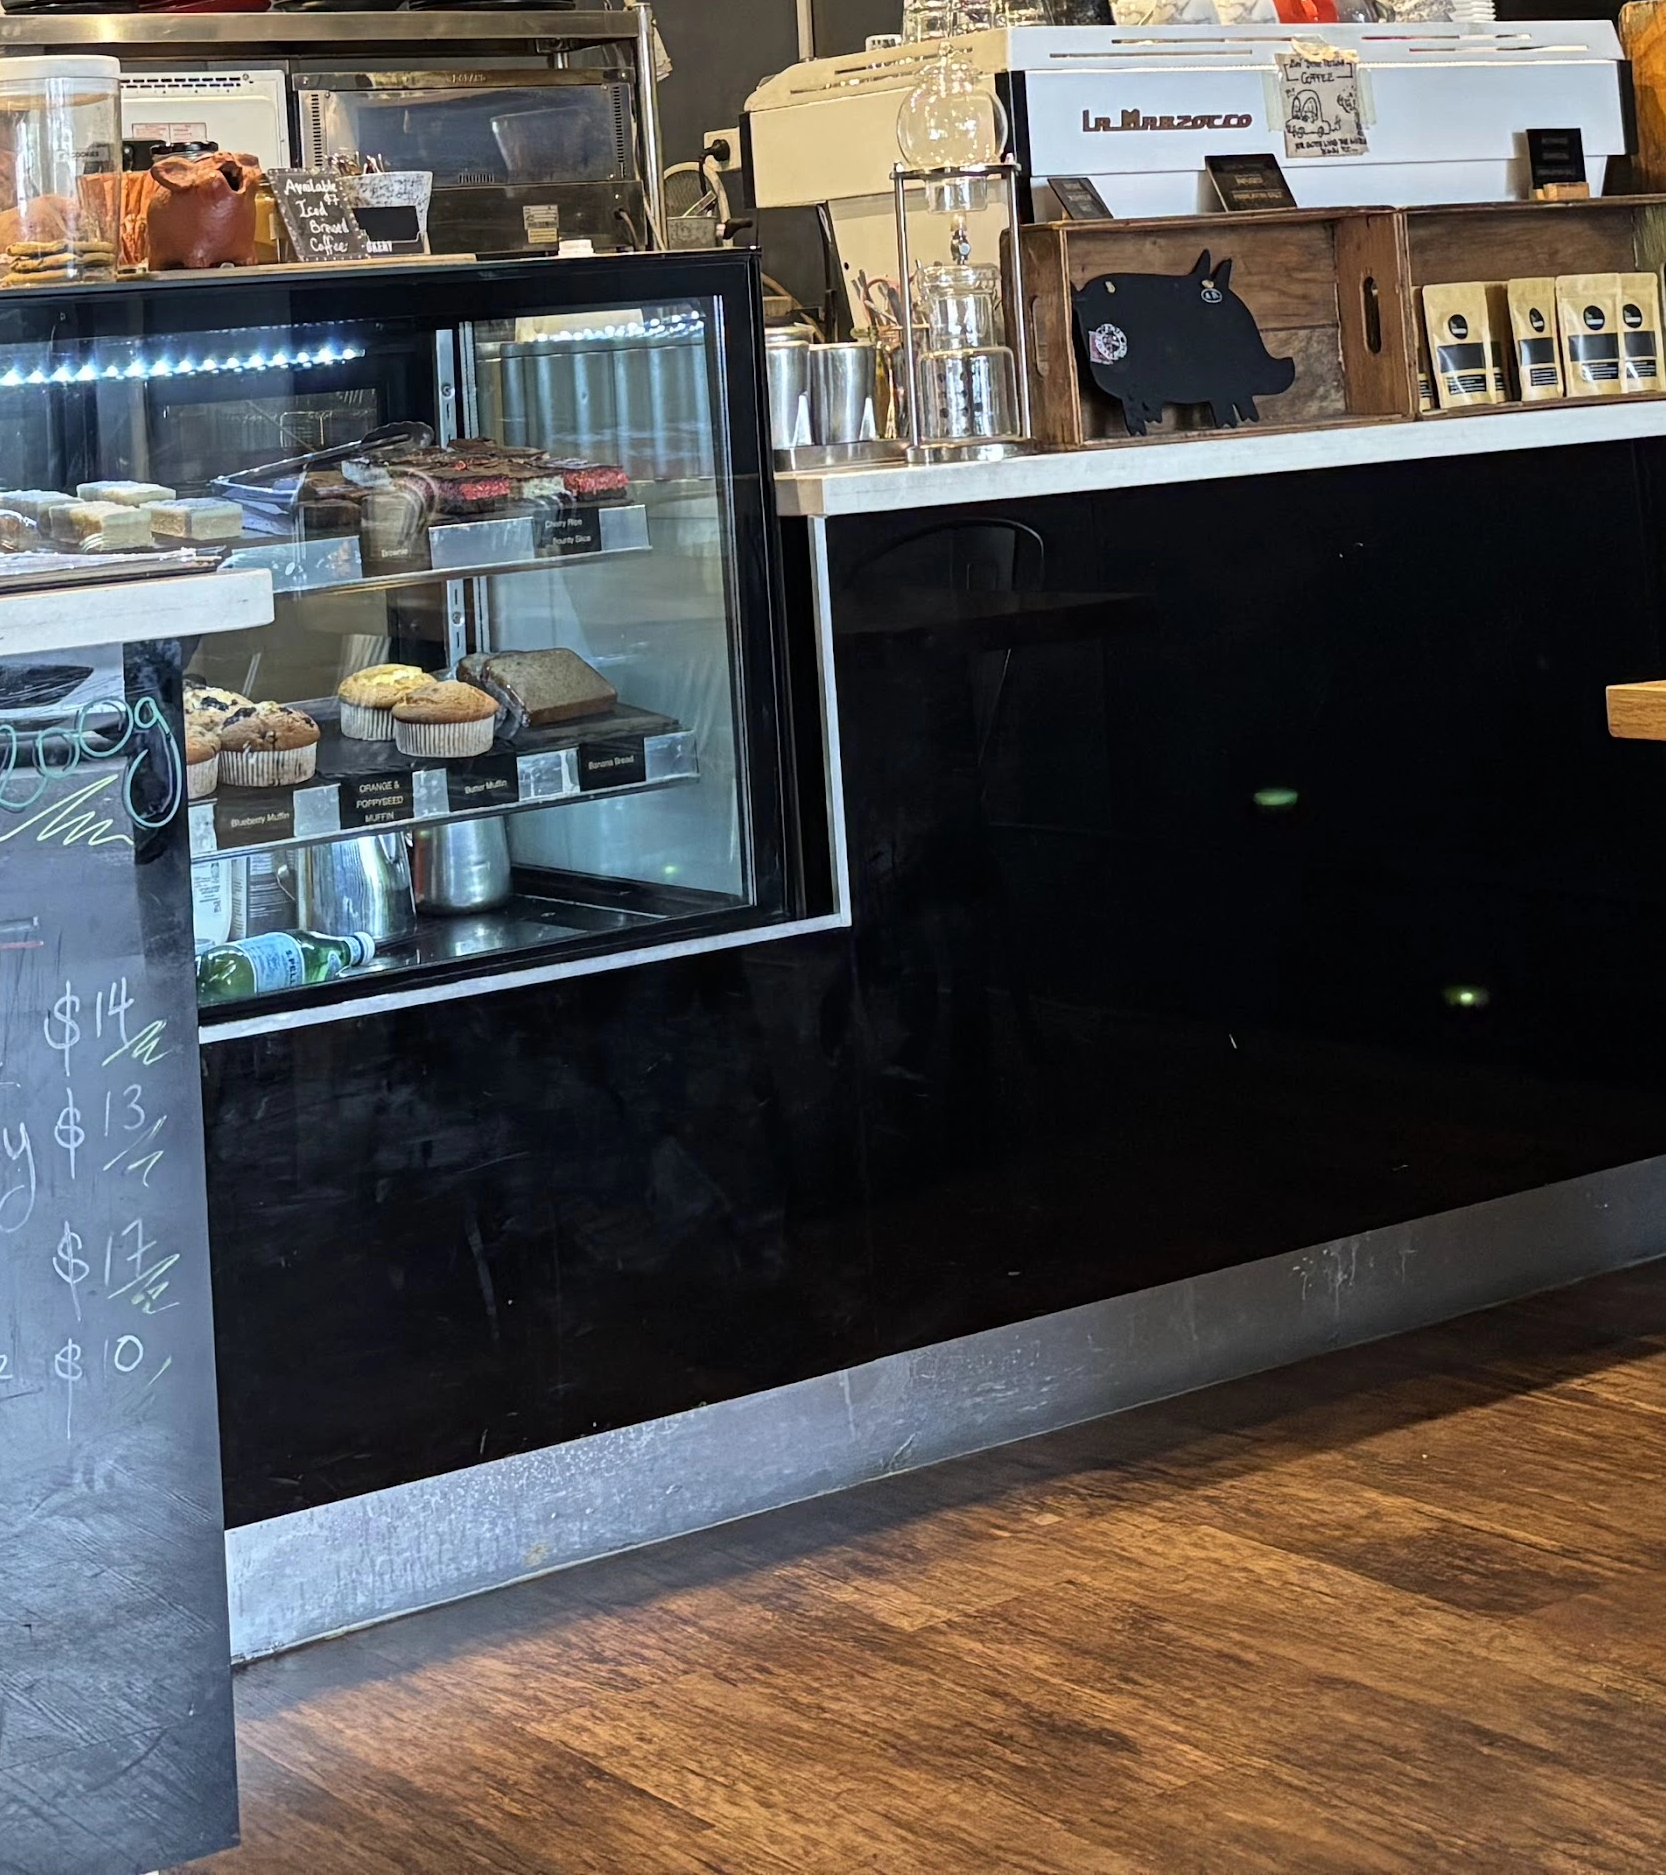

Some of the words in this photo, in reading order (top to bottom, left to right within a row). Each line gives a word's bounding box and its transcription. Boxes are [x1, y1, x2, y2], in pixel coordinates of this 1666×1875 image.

[283, 178, 339, 196] Available
[295, 198, 329, 219] Iced
[309, 235, 349, 256] Coffee
[359, 780, 393, 793] ORANGE
[356, 795, 404, 809] POPPYSEED
[230, 816, 266, 829] Blueberry
[266, 811, 290, 823] Muffin
[364, 810, 395, 823] MUFFIN
